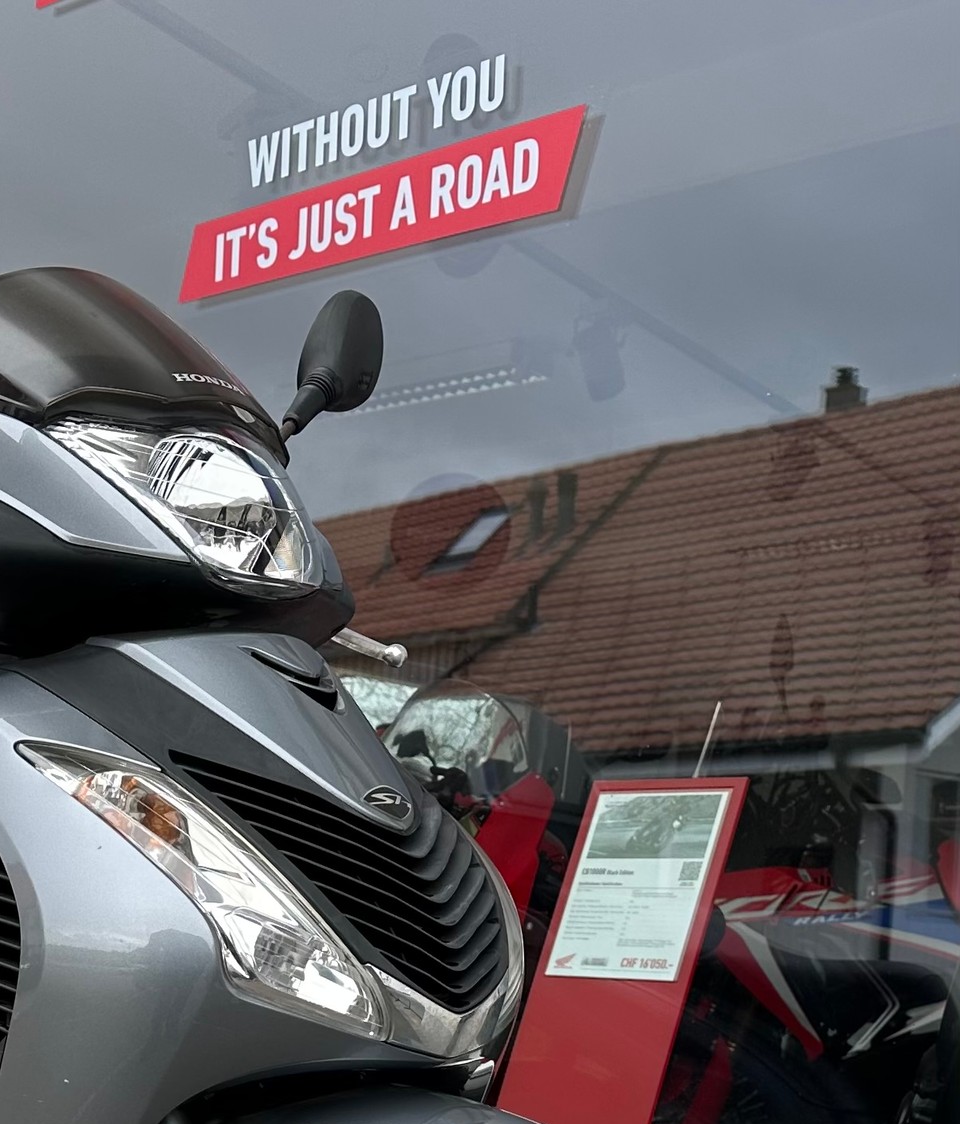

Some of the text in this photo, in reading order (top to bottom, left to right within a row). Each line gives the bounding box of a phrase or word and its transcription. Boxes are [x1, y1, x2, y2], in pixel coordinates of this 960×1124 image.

[248, 53, 506, 188] WITHOUT YOU
[213, 138, 540, 283] IT'S JUST A ROAD
[171, 372, 247, 396] HONDA
[792, 910, 870, 926] RALLY
[620, 957, 638, 968] CHF
